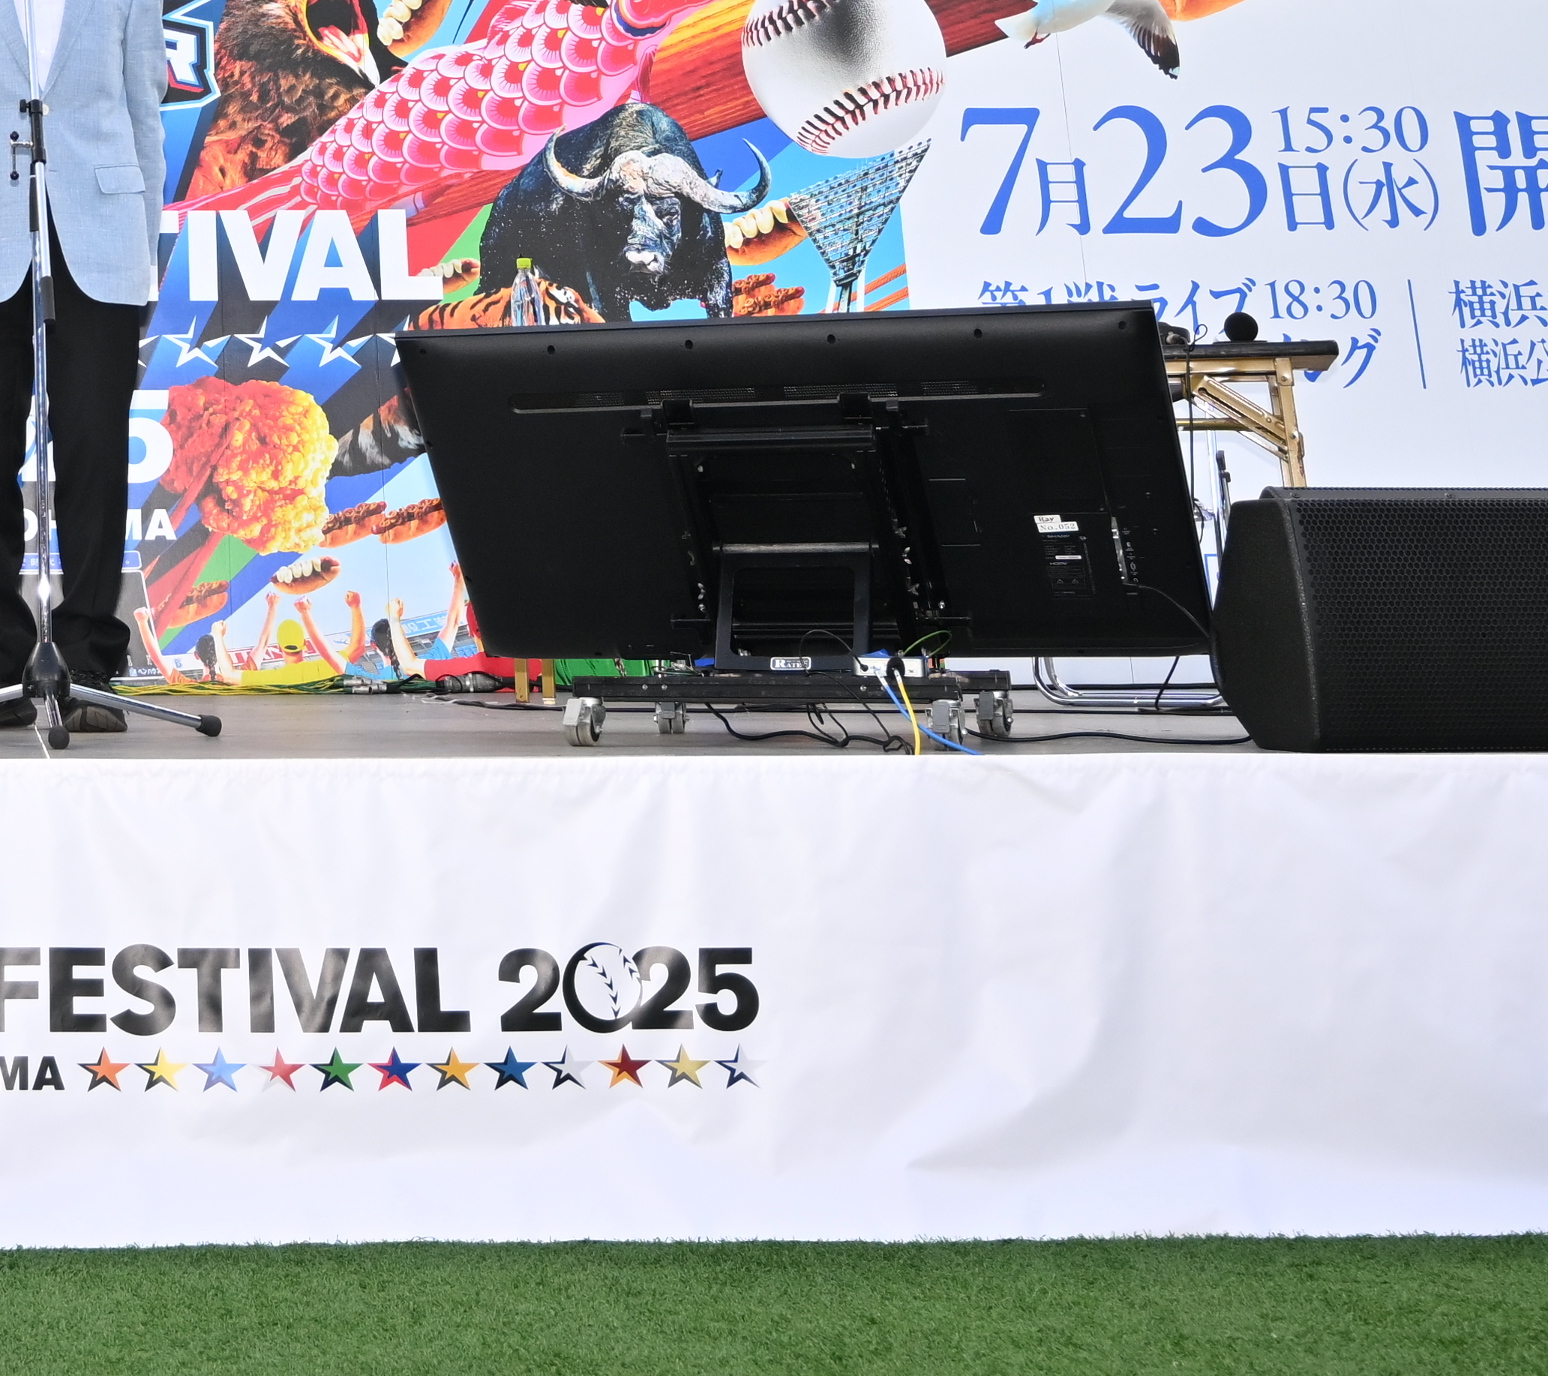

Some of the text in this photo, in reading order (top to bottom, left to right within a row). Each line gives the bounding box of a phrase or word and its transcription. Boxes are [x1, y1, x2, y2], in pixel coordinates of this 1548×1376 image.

[1275, 105, 1430, 154] 15:30
[1265, 278, 1378, 321] 18:30
[498, 941, 760, 1034] 2025
